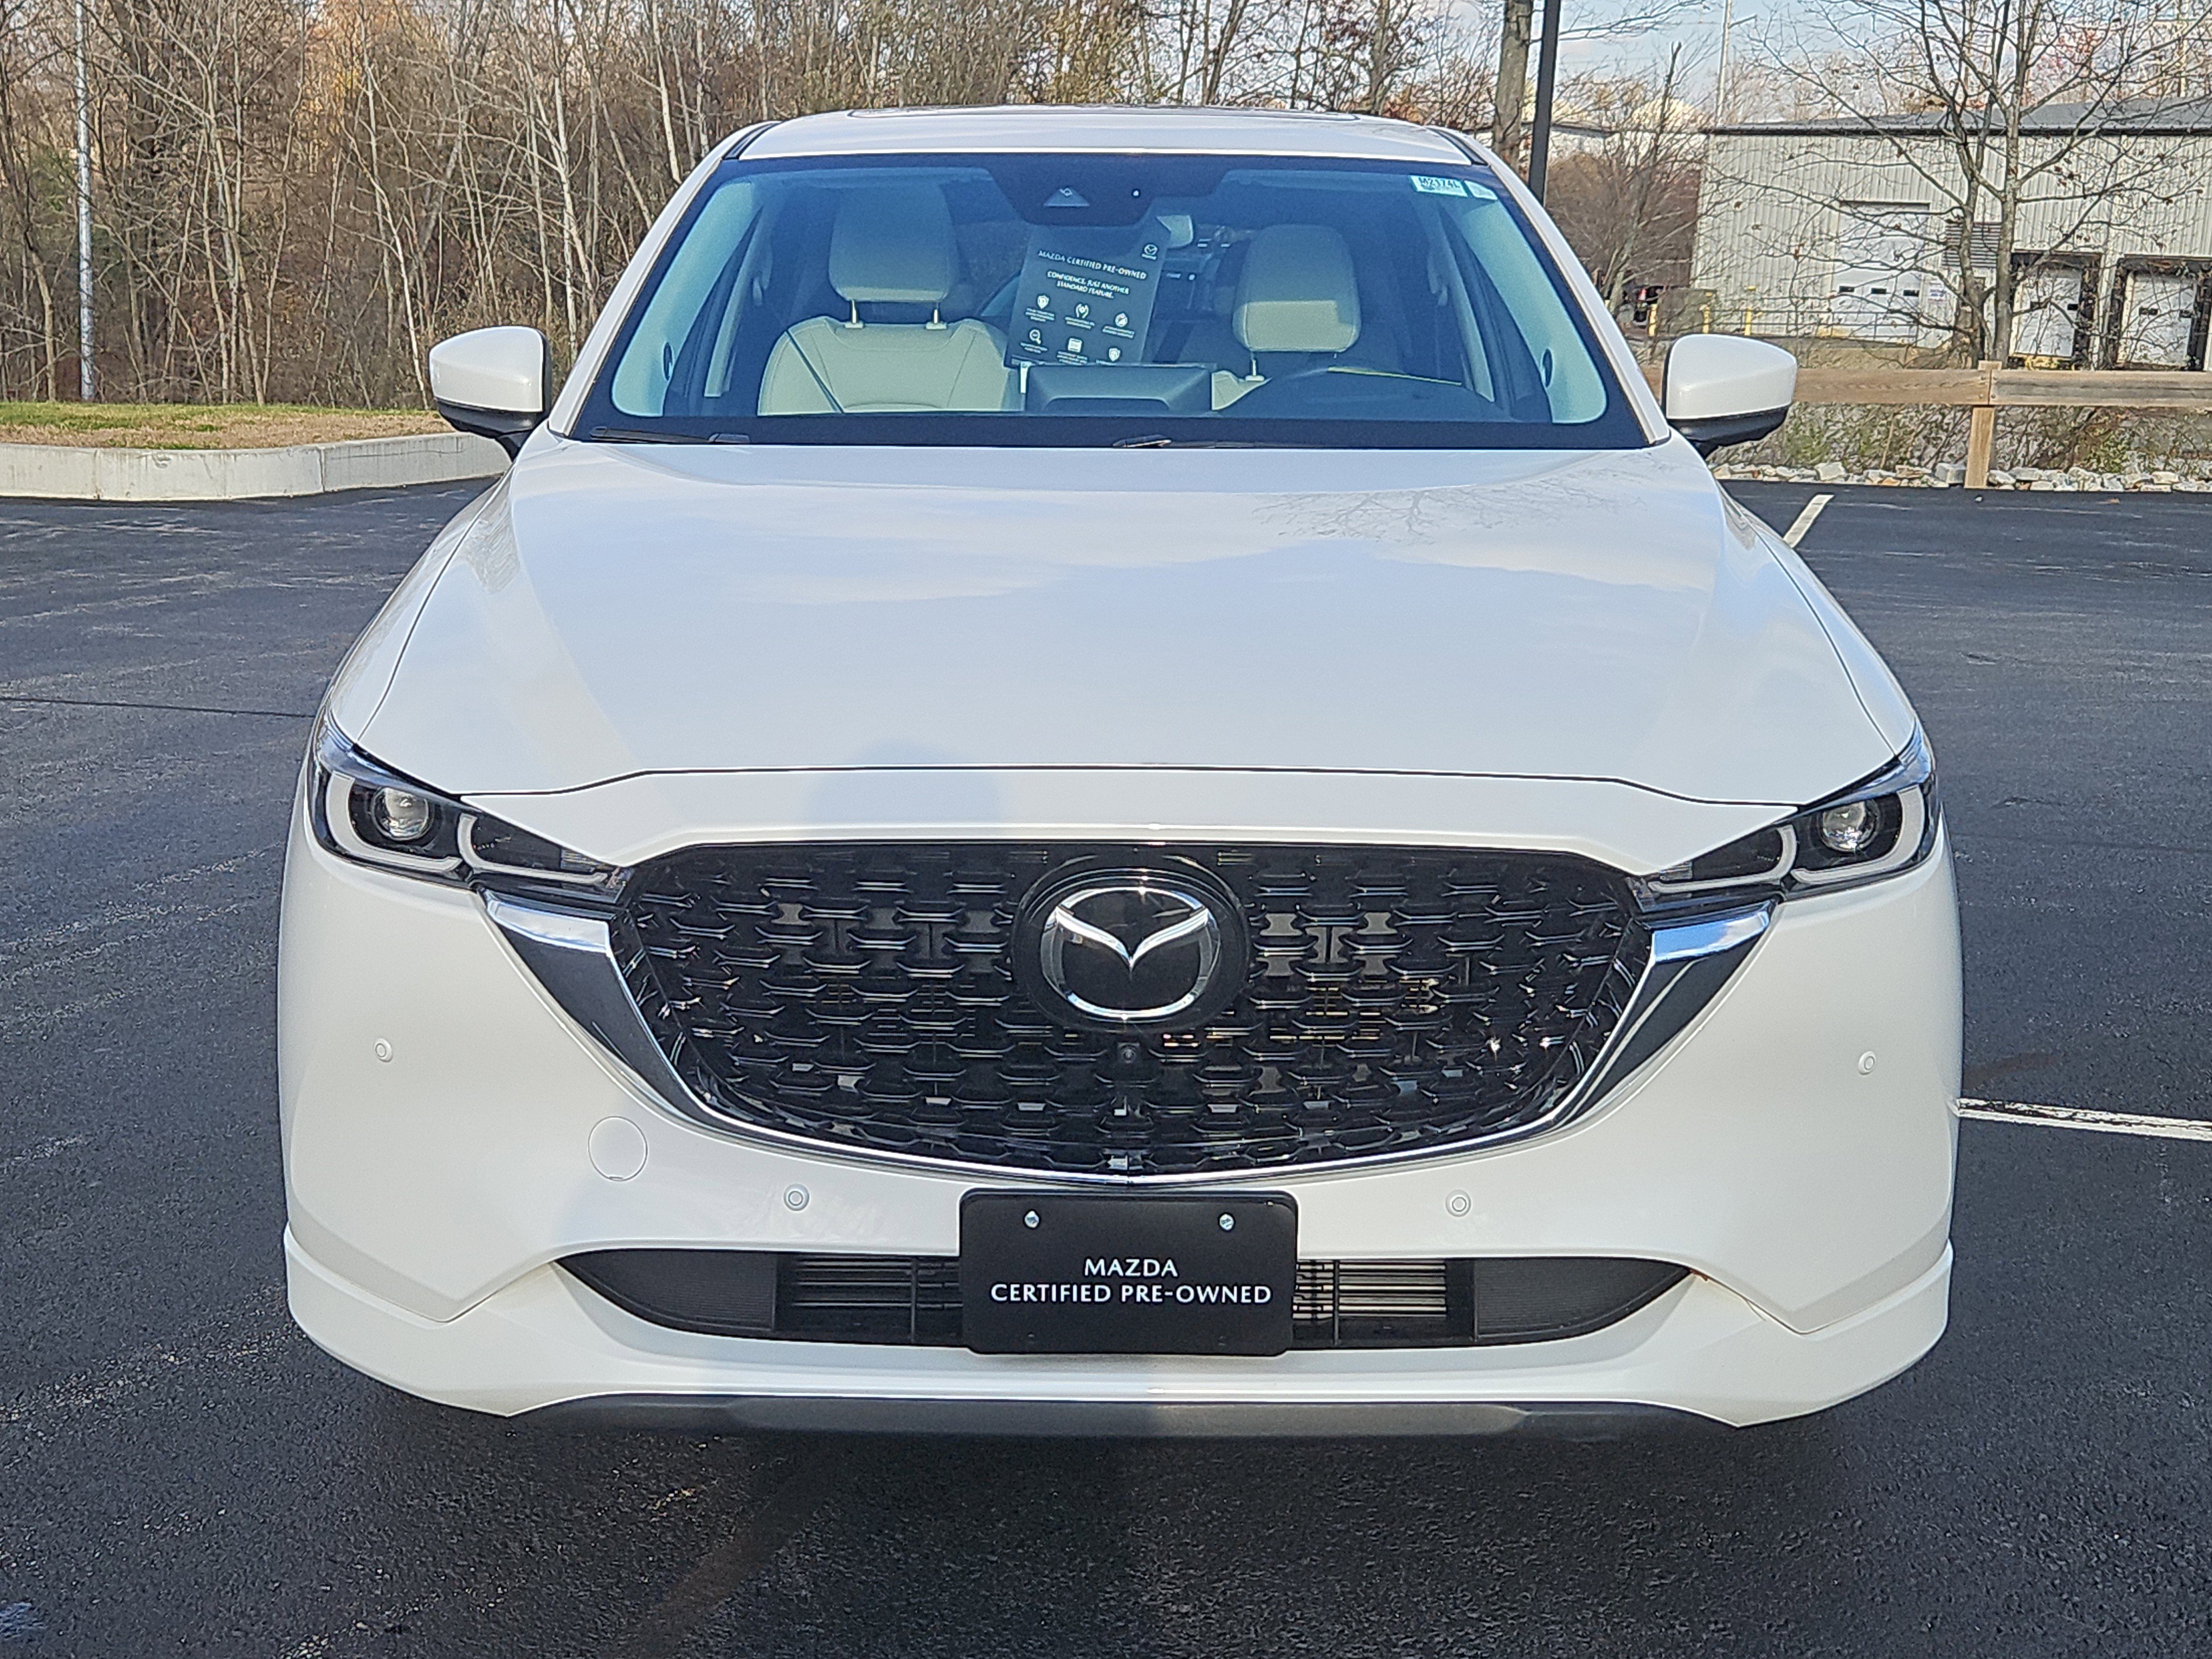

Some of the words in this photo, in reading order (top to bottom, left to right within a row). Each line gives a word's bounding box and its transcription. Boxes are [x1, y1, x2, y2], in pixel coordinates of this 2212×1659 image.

[1038, 250, 1065, 261] MAZDA
[1084, 1258, 1178, 1277] MAZDA
[990, 1284, 1111, 1302] CERTIFIED
[1121, 1284, 1271, 1303] PRE-OWNED
